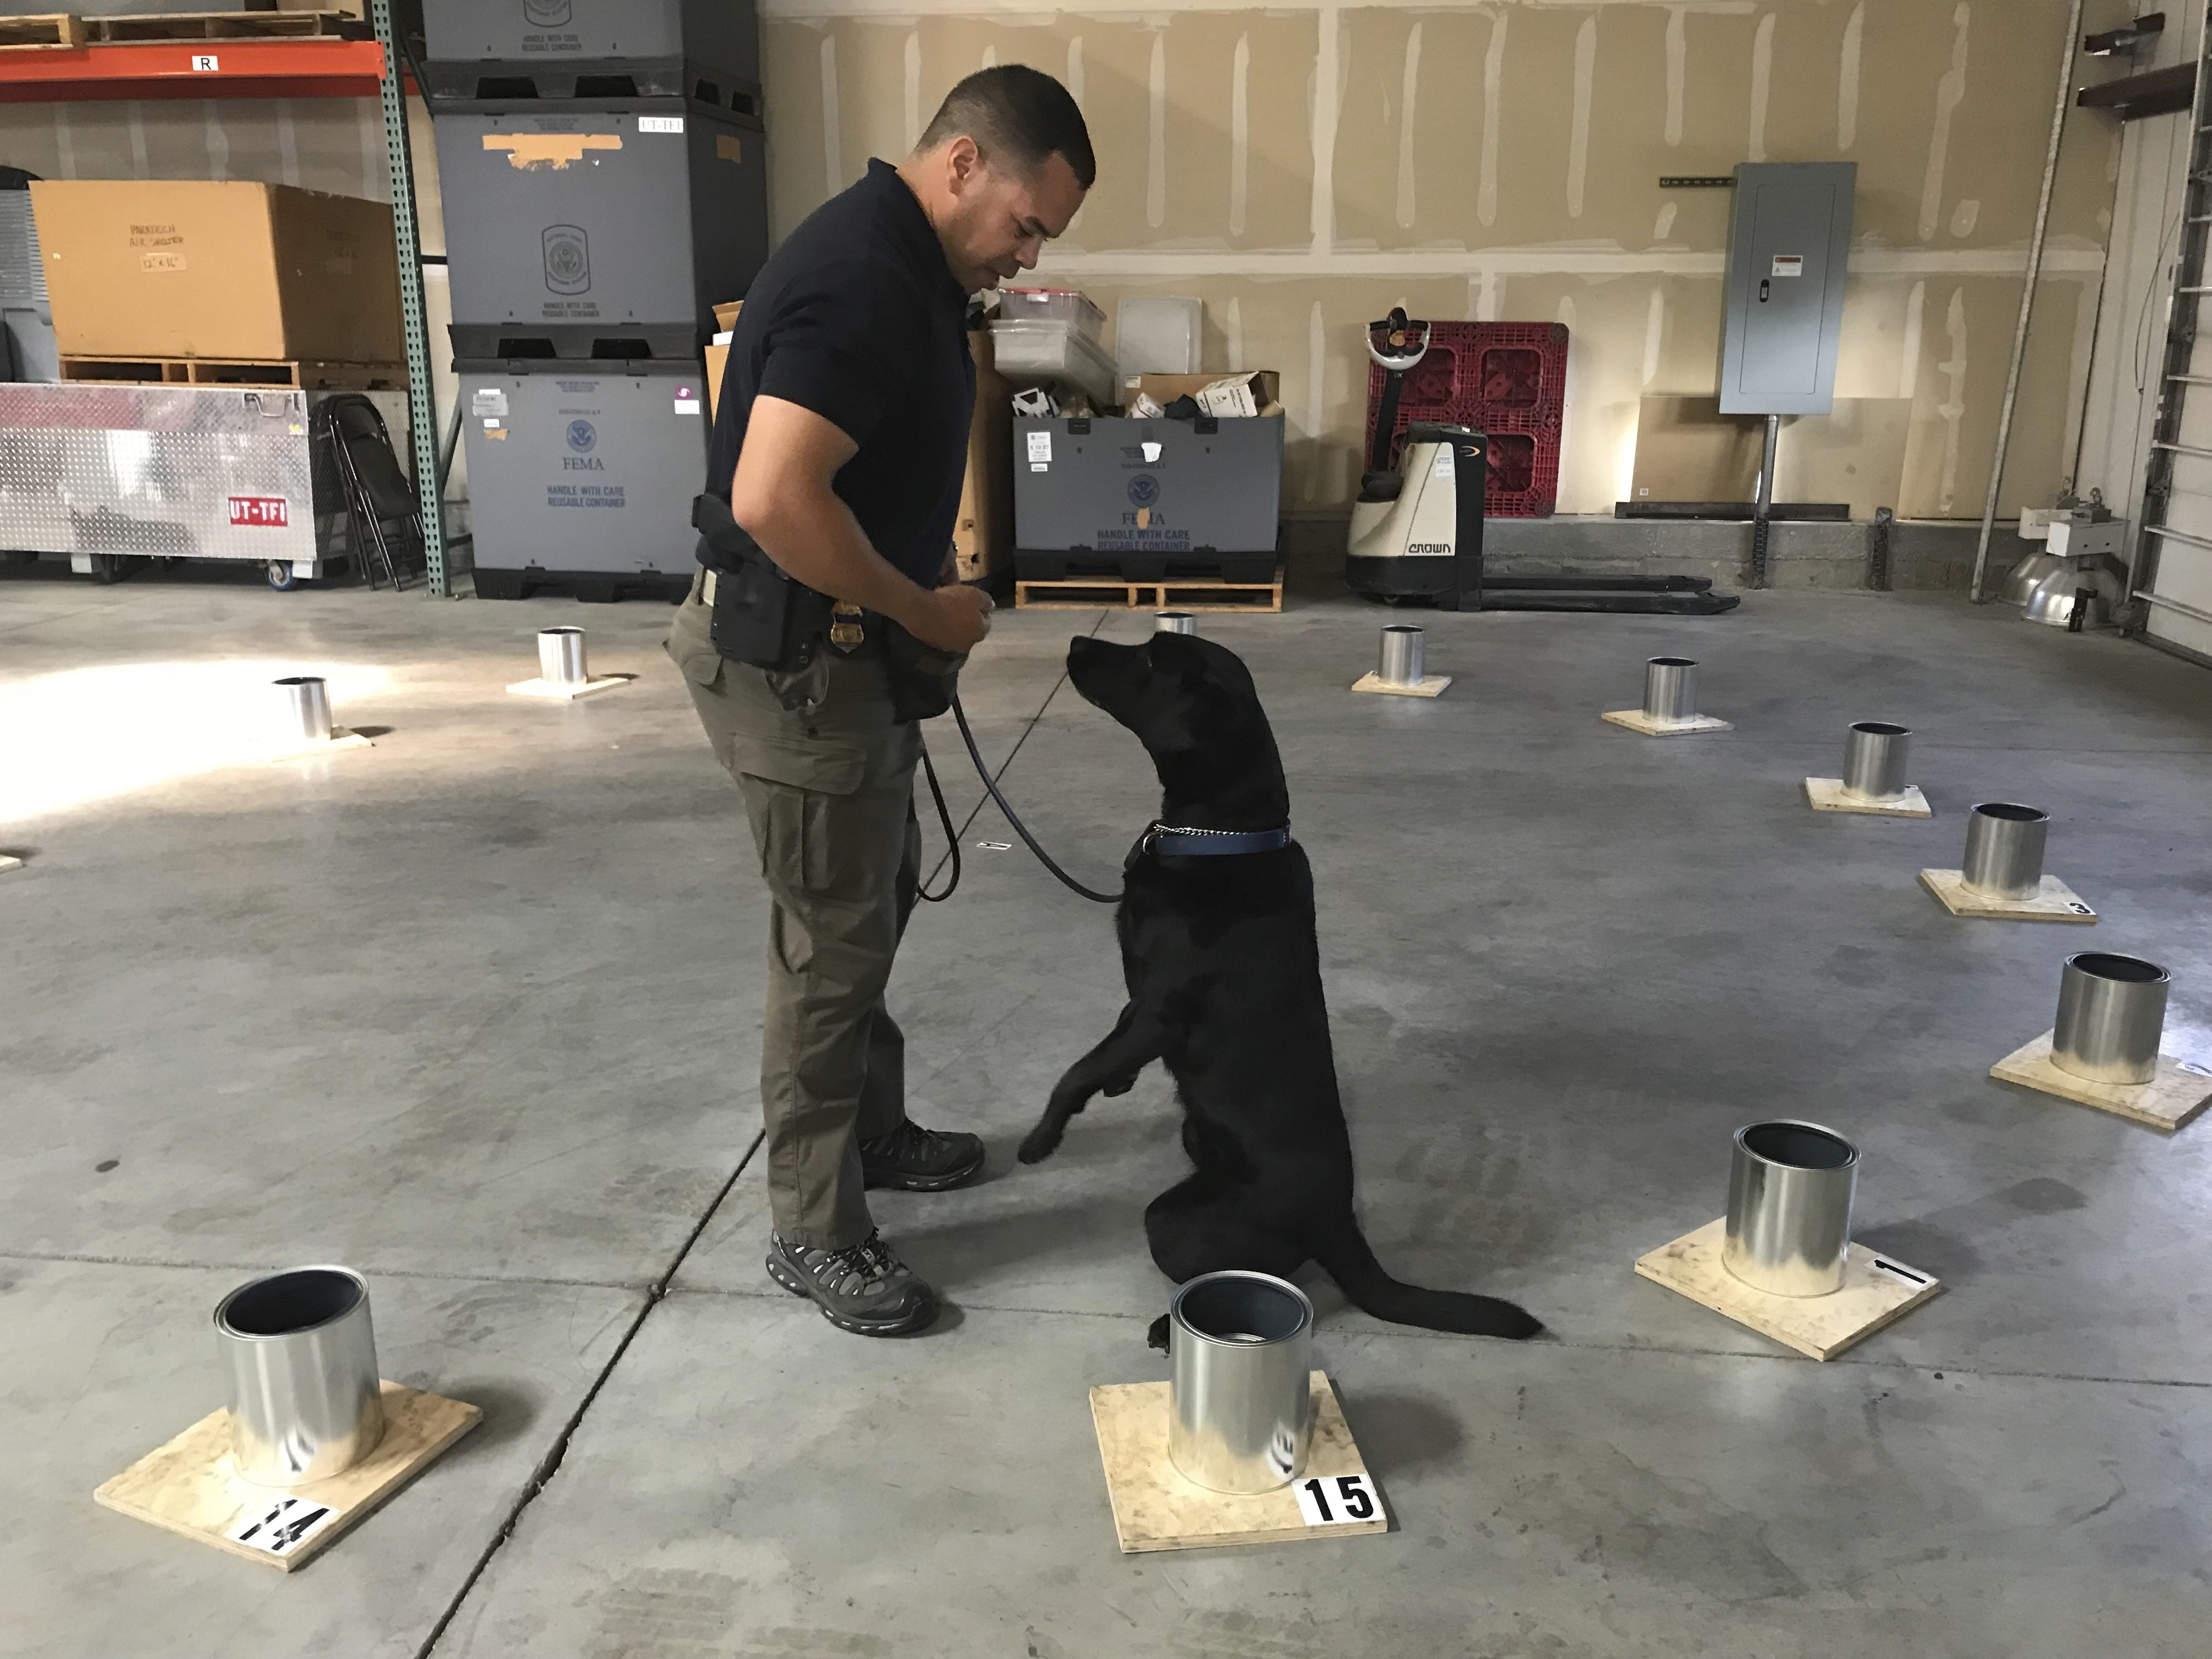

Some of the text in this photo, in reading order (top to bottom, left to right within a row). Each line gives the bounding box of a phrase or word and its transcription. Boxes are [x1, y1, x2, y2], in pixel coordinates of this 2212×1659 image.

[201, 57, 211, 70] R
[563, 457, 605, 471] FEMA
[547, 486, 624, 496] HANDLE WITH CARE
[548, 496, 625, 508] REUSABLE CONTAINER
[1122, 512, 1166, 525] FEA
[1097, 530, 1190, 539] HANDLE WITH CARE
[1098, 541, 1190, 551] REUSABLE CONTAINER
[1408, 544, 1451, 553] CROWN
[2069, 902, 2091, 914] 3
[1874, 1259, 1927, 1284] 1
[1304, 1476, 1374, 1521] 15
